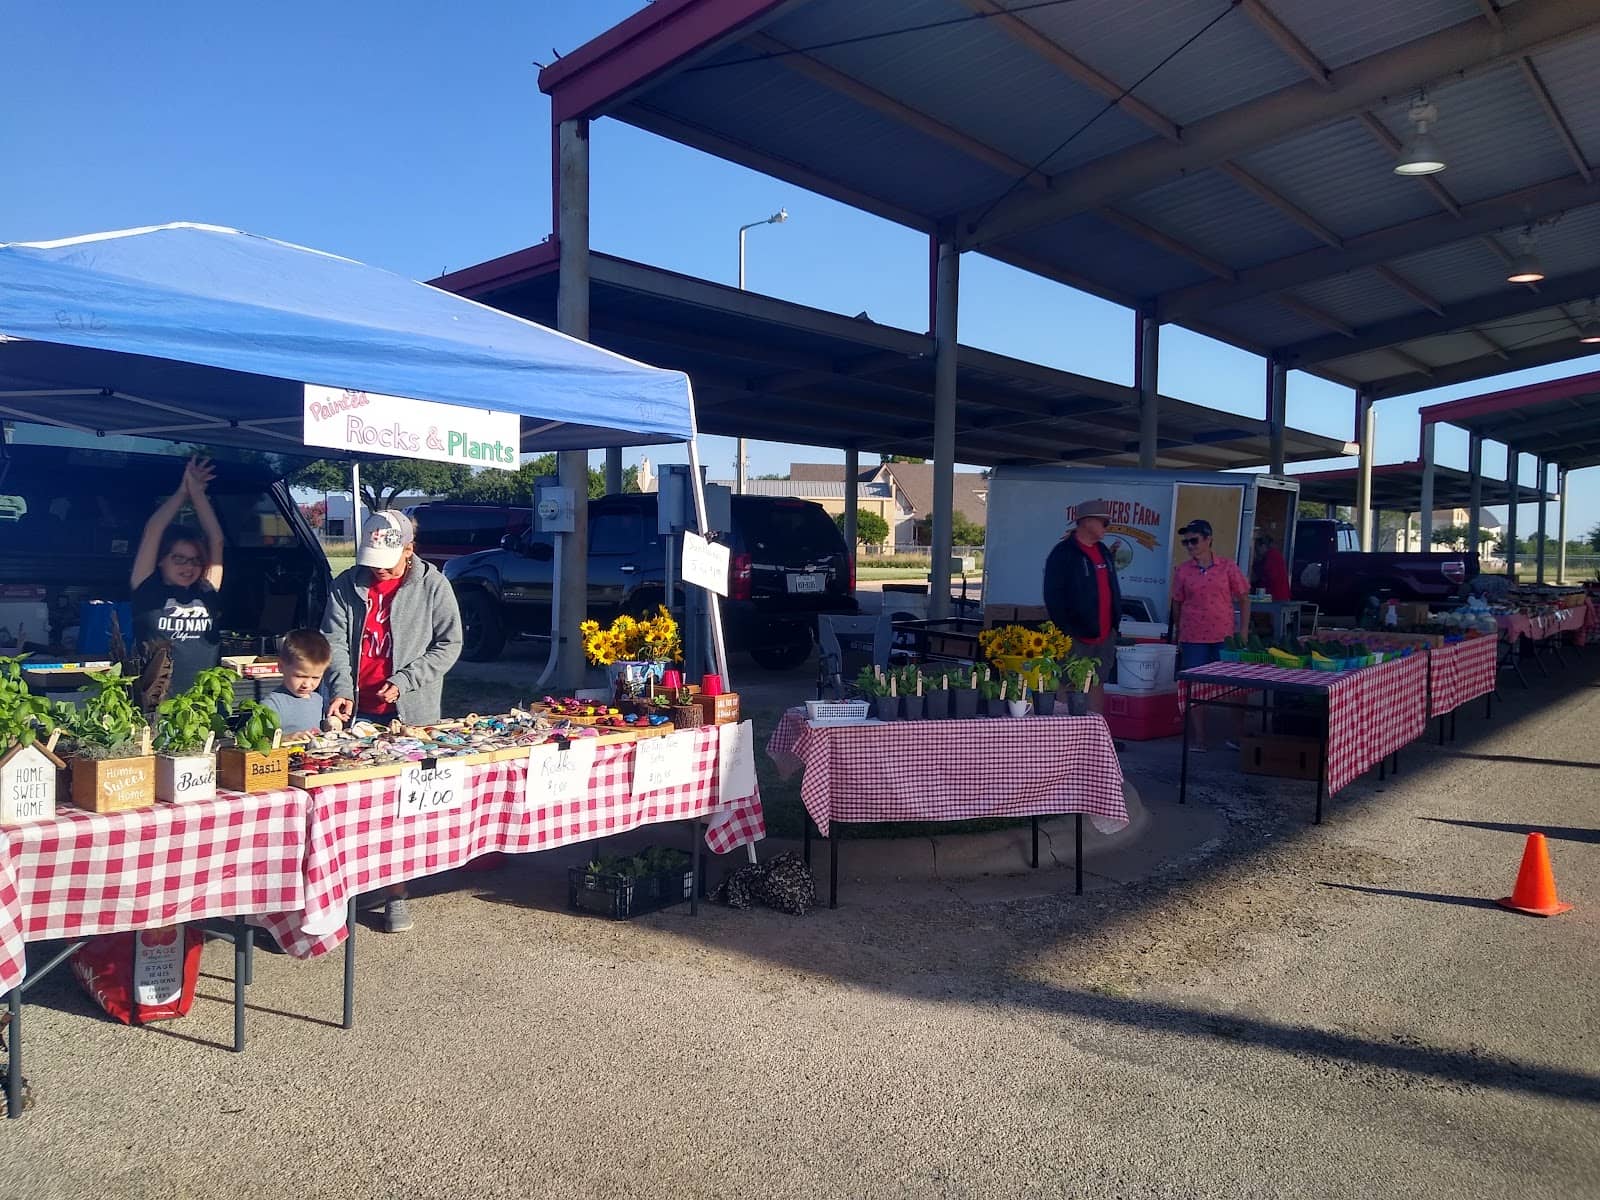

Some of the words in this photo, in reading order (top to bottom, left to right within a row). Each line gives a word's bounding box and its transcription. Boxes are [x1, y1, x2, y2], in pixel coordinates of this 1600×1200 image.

[346, 414, 420, 452] Rocks
[425, 425, 445, 451] &
[447, 430, 514, 464] Plants
[1132, 501, 1161, 526] FARM
[158, 616, 184, 632] OLD
[185, 617, 214, 632] NAVY
[16, 766, 45, 783] HOME
[252, 759, 282, 775] Basil
[409, 767, 452, 785] Rocks
[103, 769, 146, 797] Sweet
[176, 770, 215, 792] Basil
[12, 782, 48, 801] SWEET
[407, 789, 454, 811] $1.00
[16, 800, 45, 817] HOME
